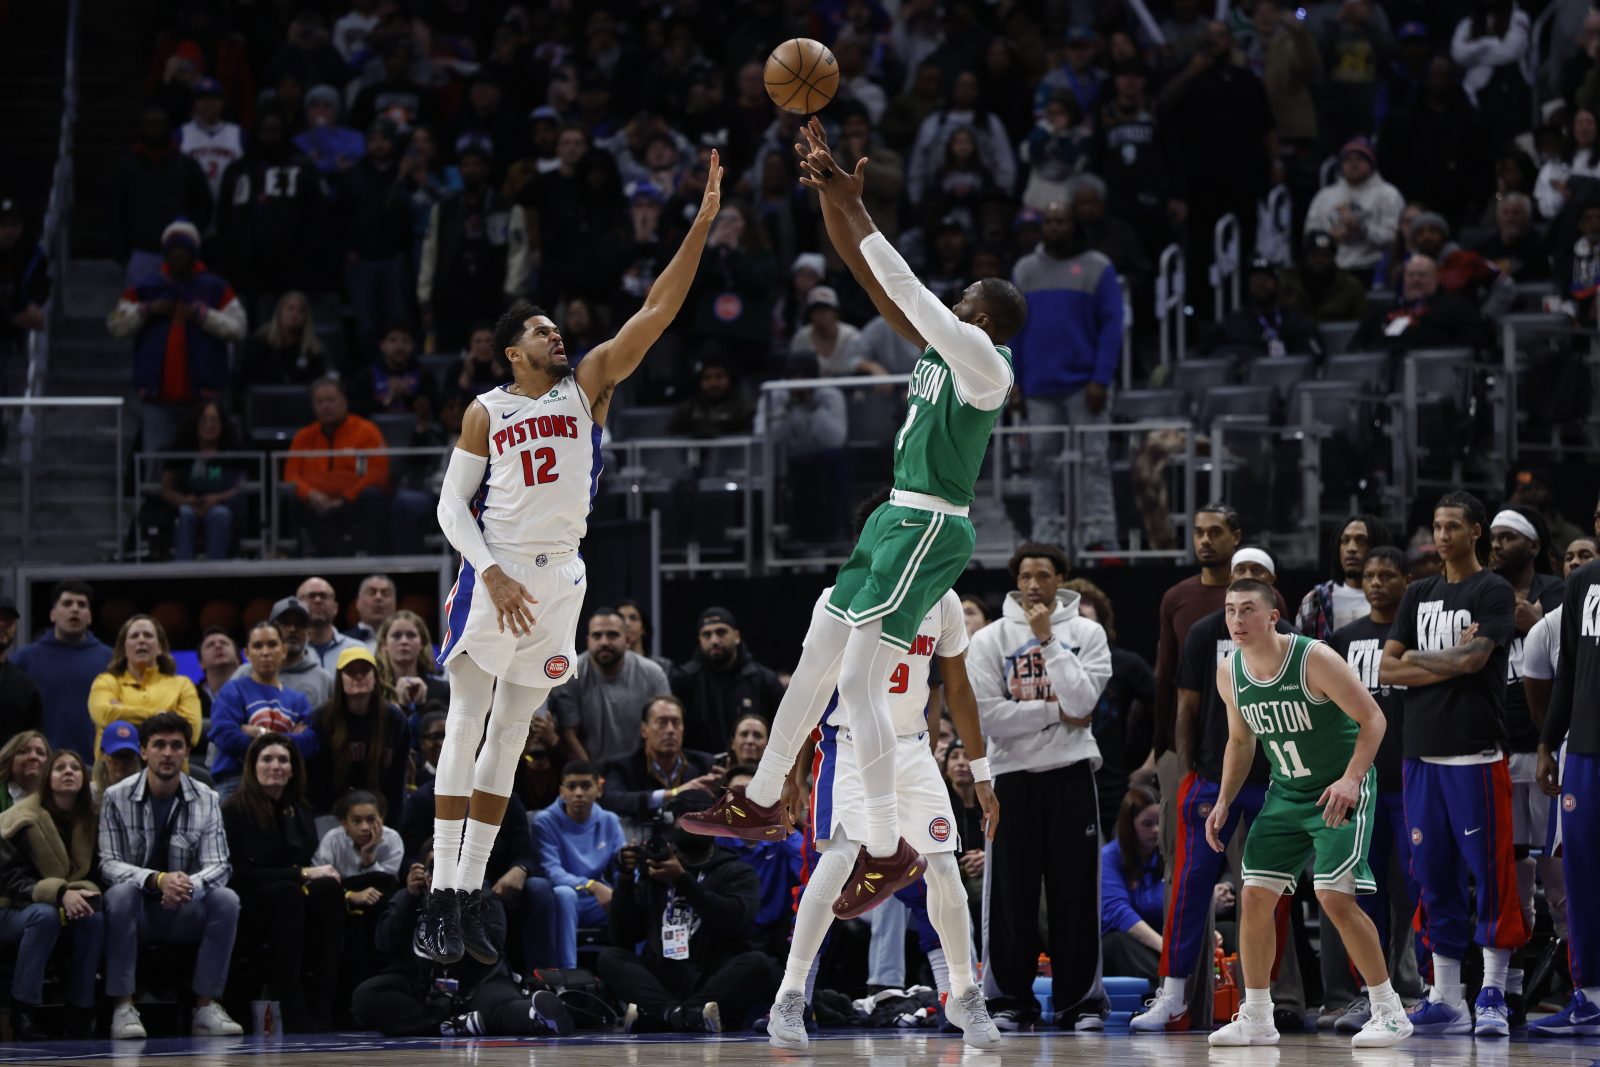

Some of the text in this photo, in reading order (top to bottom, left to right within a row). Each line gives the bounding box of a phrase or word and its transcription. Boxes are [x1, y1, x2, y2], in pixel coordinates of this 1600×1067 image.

[492, 414, 578, 457] PISTONS
[520, 446, 560, 487] 12
[888, 662, 910, 694] 9
[1279, 683, 1300, 692] Amica
[1240, 700, 1314, 735] BOSTON
[1268, 740, 1312, 779] 11
